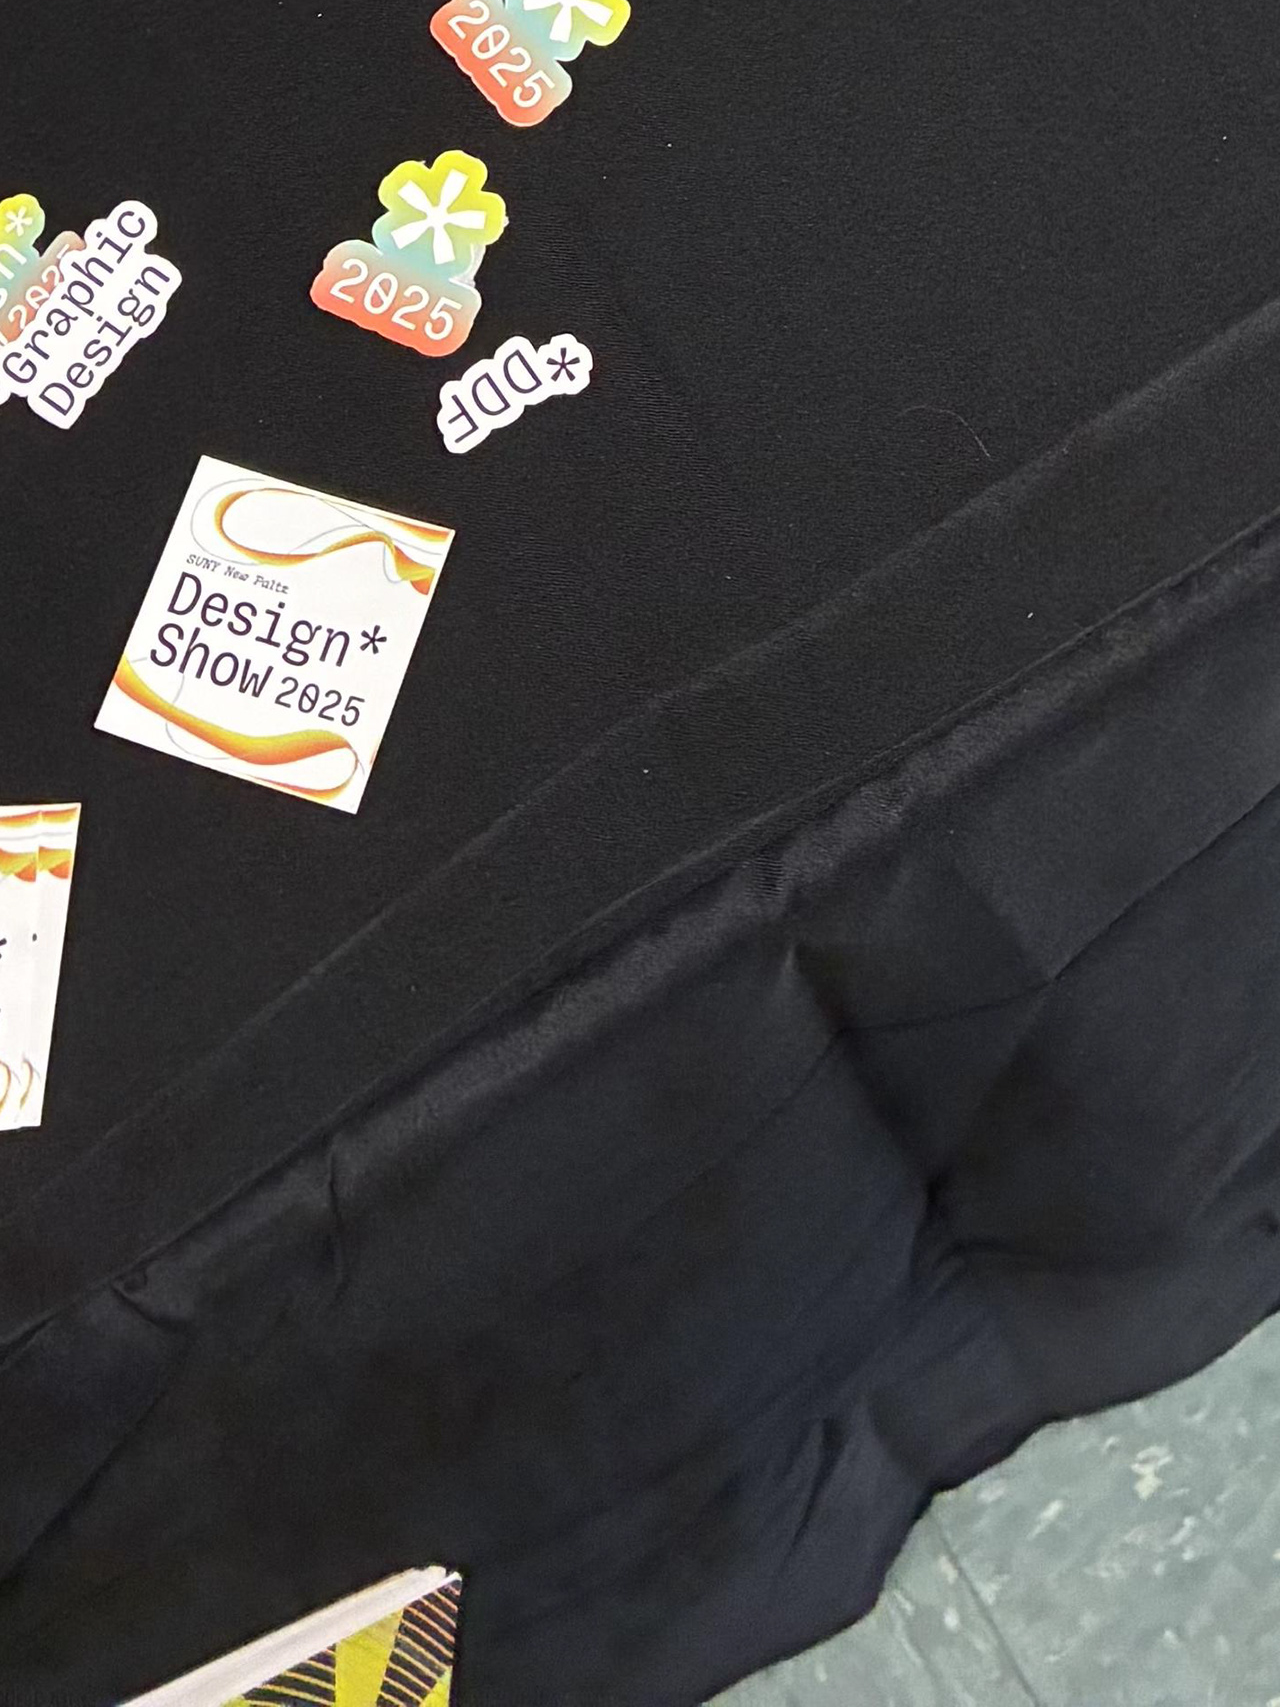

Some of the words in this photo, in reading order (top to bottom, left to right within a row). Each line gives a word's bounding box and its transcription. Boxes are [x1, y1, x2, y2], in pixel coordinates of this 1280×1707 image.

[447, 0, 556, 109] 2025
[38, 262, 171, 418] Design
[329, 257, 463, 342] 2025
[149, 621, 274, 699] Show
[274, 675, 366, 727] 2025
